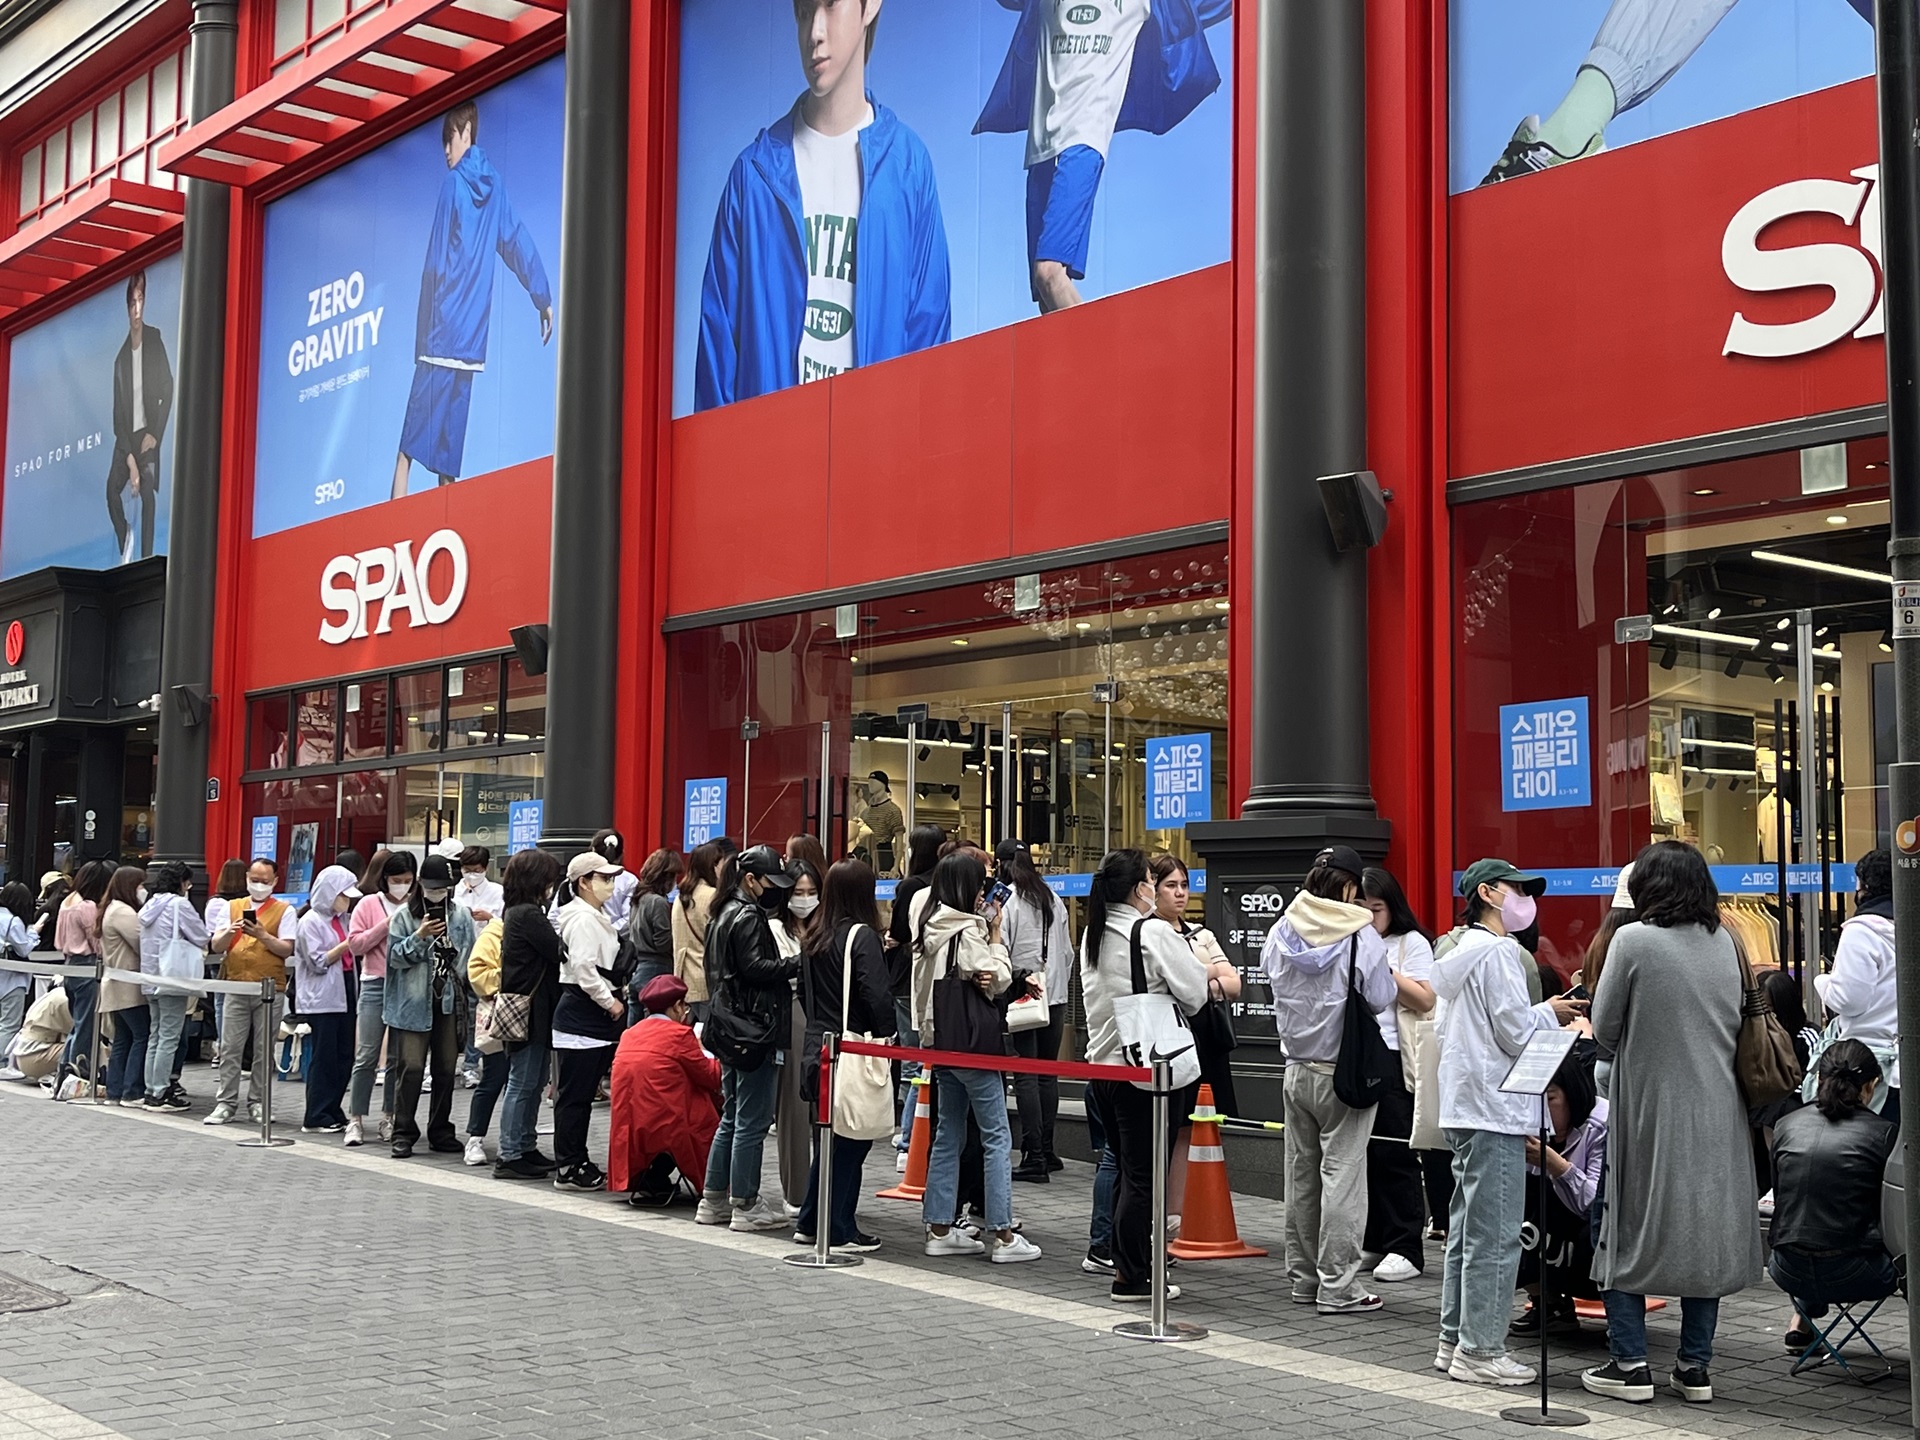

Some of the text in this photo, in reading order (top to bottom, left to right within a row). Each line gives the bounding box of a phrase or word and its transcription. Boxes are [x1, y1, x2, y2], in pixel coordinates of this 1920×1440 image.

[307, 271, 365, 327] ZERO
[288, 306, 384, 377] GRAVITY
[14, 431, 102, 478] SPAO FOR MEN
[315, 479, 345, 505] SPAO
[319, 529, 470, 644] SPAO
[1904, 610, 1914, 624] 6
[1511, 709, 1578, 742] 스파오
[1153, 743, 1203, 771] 스파오
[1511, 738, 1578, 770] 패밀리
[1153, 768, 1203, 795] 패밀리
[1512, 769, 1557, 799] 데이
[690, 785, 722, 806] 스파오
[513, 807, 540, 825] 스파오
[689, 805, 721, 826] 패밀리
[1153, 794, 1186, 819] 데이
[255, 822, 275, 837] 스파오
[1065, 815, 1079, 828] 3F
[512, 824, 539, 843] 패밀리
[688, 825, 710, 845] 데이
[1897, 858, 1920, 869] 서울중
[1591, 874, 1618, 888] 스파오
[1741, 872, 1774, 886] 스파오
[1240, 894, 1284, 911] SPAO
[1229, 930, 1244, 943] 3F
[1231, 1002, 1244, 1016] 1F
